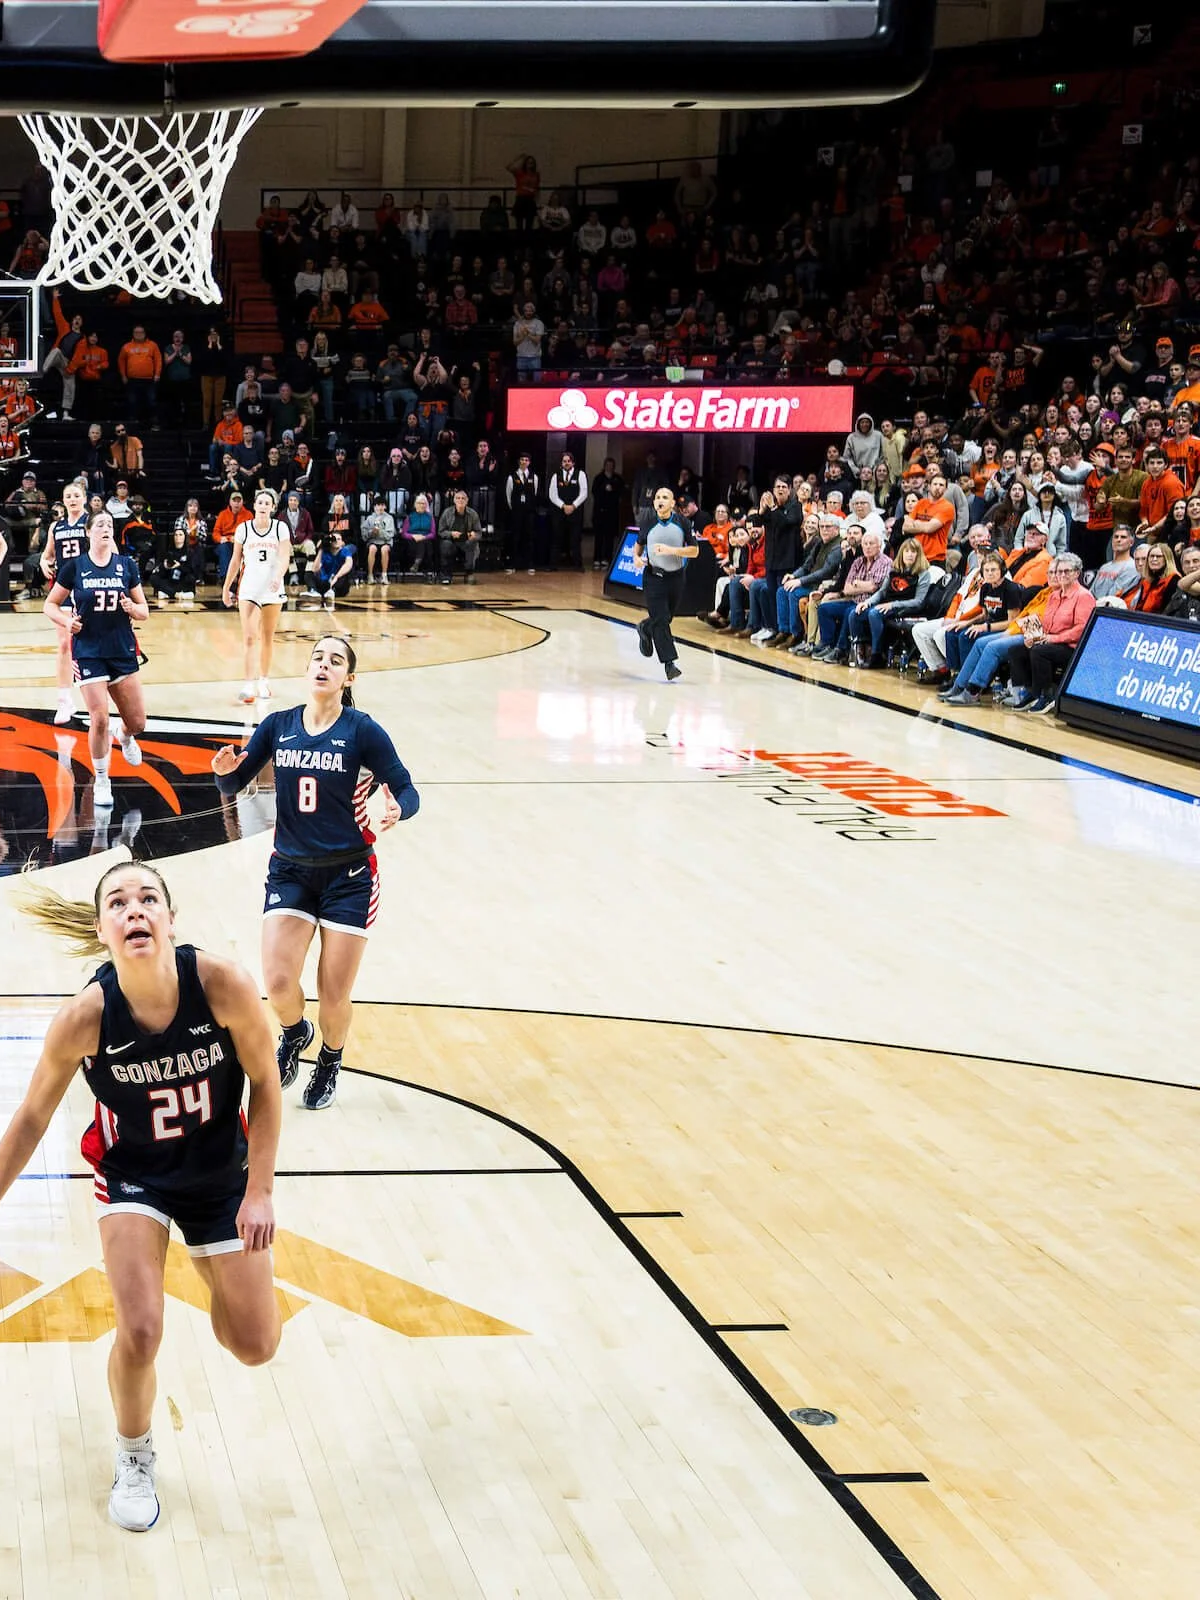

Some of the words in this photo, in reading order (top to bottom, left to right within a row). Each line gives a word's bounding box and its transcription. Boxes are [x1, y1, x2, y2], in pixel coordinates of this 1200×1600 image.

[62, 539, 81, 559] 23
[258, 549, 267, 562] 3
[81, 577, 125, 589] GONZAGA
[94, 590, 119, 612] 33
[1123, 631, 1178, 668] Health
[1116, 669, 1140, 698] do
[1142, 675, 1194, 711] what's
[276, 749, 343, 772] GONZAGA
[298, 775, 318, 813] 8
[189, 1023, 212, 1036] WCC
[110, 1041, 225, 1084] GONZAGA
[148, 1077, 213, 1142] 24
